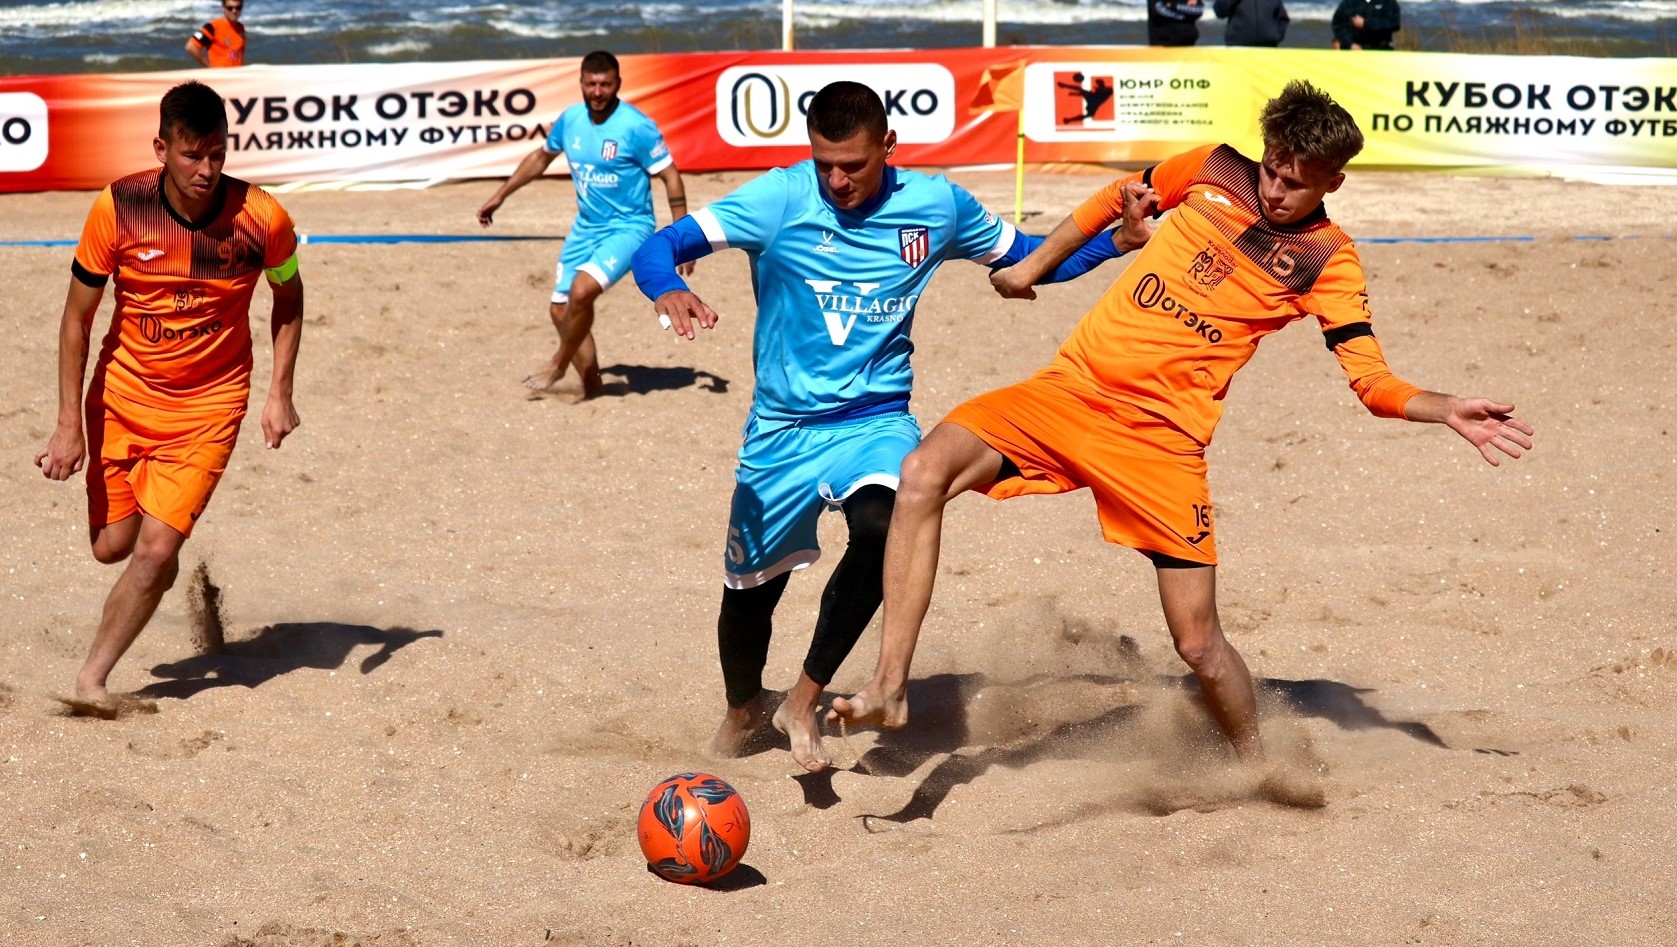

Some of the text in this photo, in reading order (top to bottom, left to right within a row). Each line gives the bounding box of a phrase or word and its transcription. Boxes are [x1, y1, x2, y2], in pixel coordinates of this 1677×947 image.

[1119, 78, 1211, 90] ЮМР ОПФ
[1405, 81, 1677, 112] КУБОК ОТЭК
[222, 88, 537, 125] УБОК ОТЭКО
[797, 88, 939, 117] ОКО
[0, 117, 32, 145] О
[418, 123, 553, 145] ФУТБОЛ
[1372, 113, 1677, 137] ПО ПЛЯЖНОМУ ФУТБ
[1262, 237, 1302, 278] 16
[162, 320, 223, 341] ОТЭКО
[1161, 296, 1223, 344] ОТЭКО
[1191, 504, 1210, 528] 16
